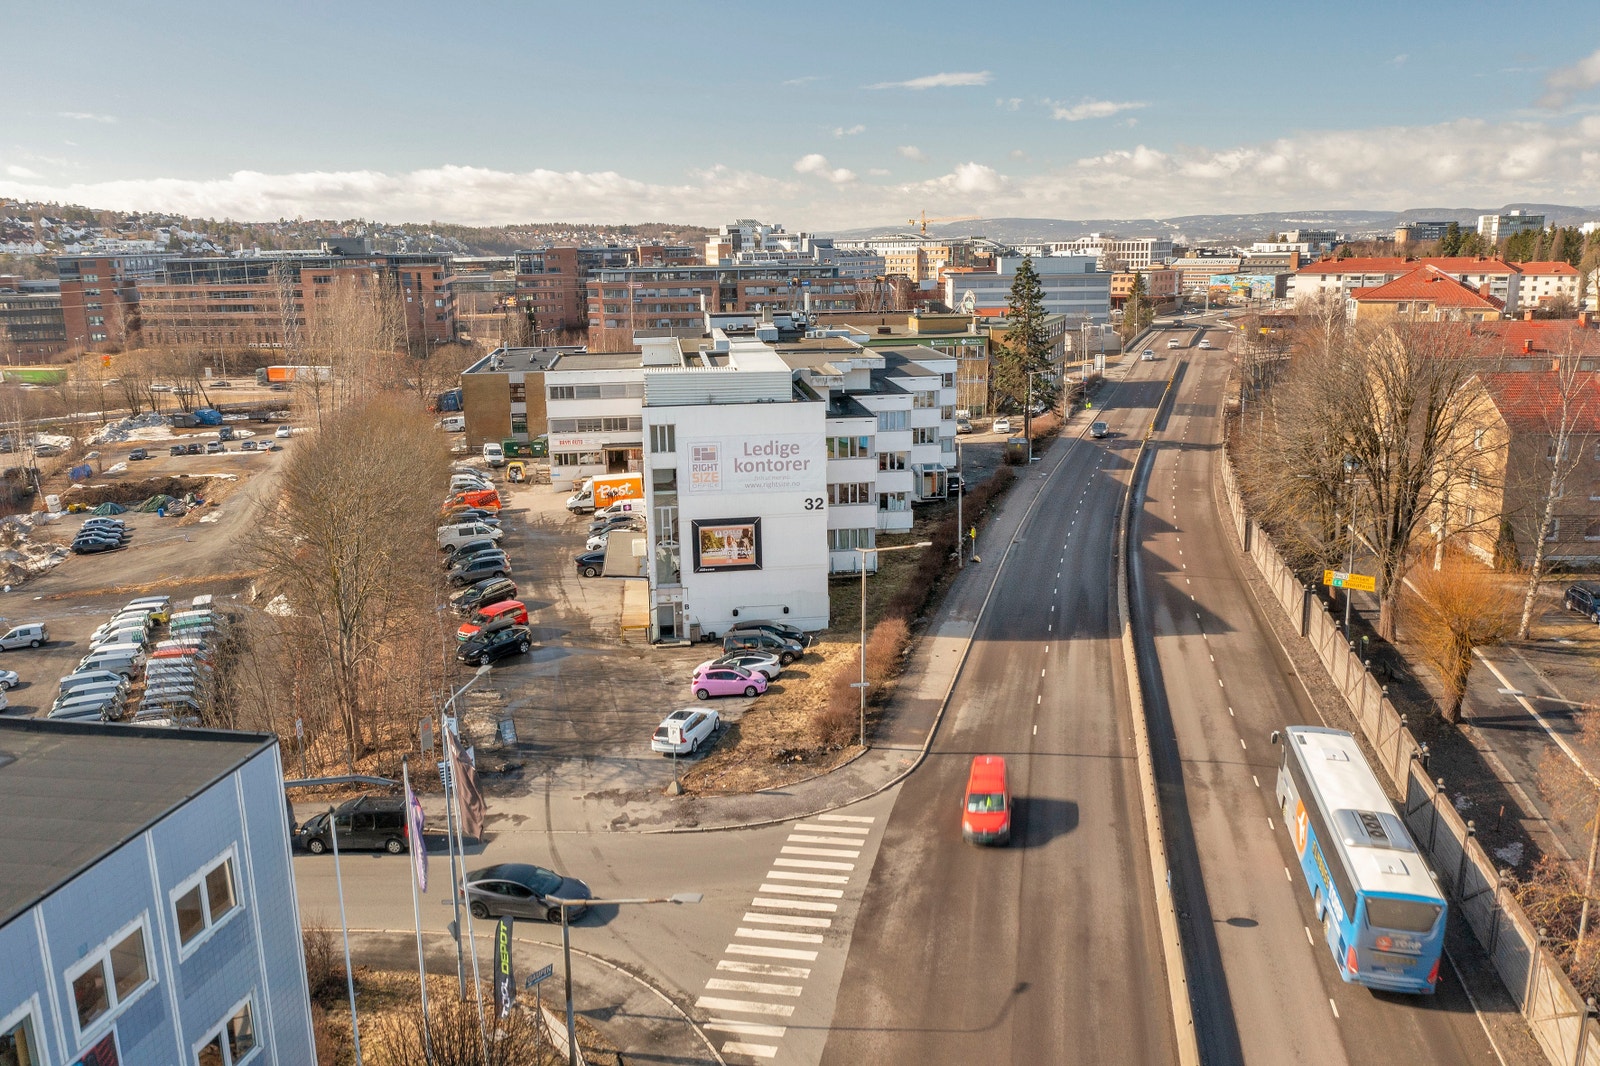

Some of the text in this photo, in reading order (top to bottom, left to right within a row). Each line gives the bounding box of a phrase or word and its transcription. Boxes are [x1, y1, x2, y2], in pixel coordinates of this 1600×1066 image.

[744, 440, 800, 458] Ledige
[692, 463, 718, 472] RIGHT
[734, 458, 810, 473] kontorer
[692, 472, 719, 483] SIZE
[744, 481, 800, 489] www.rightsize.no
[804, 498, 824, 510] 32
[500, 920, 510, 1018] TOOL DEPOT
